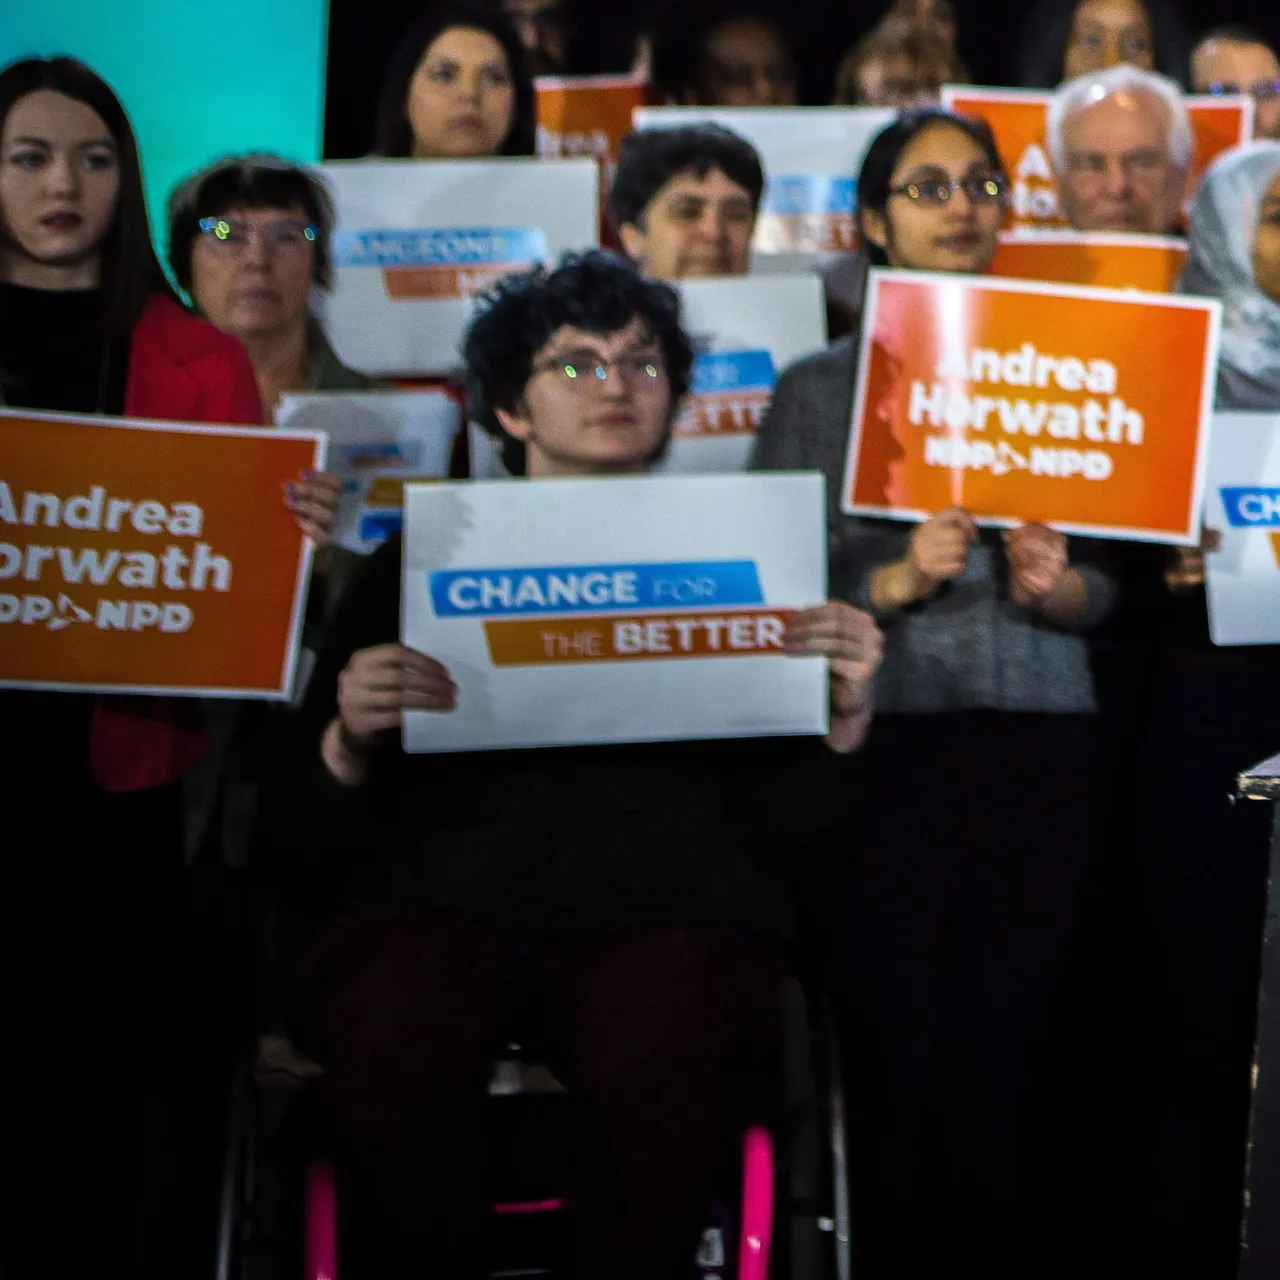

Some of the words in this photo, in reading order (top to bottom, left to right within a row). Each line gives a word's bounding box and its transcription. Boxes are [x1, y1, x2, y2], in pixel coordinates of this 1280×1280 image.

[937, 341, 1118, 395] Andrea
[908, 379, 1145, 444] Horwath
[1028, 446, 1114, 482] NPD
[0, 540, 233, 593] orwath
[446, 570, 639, 611] CHANGE
[652, 576, 719, 602] FOR
[95, 598, 194, 635] NPD
[540, 628, 603, 658] THE
[612, 614, 785, 655] BETTER
